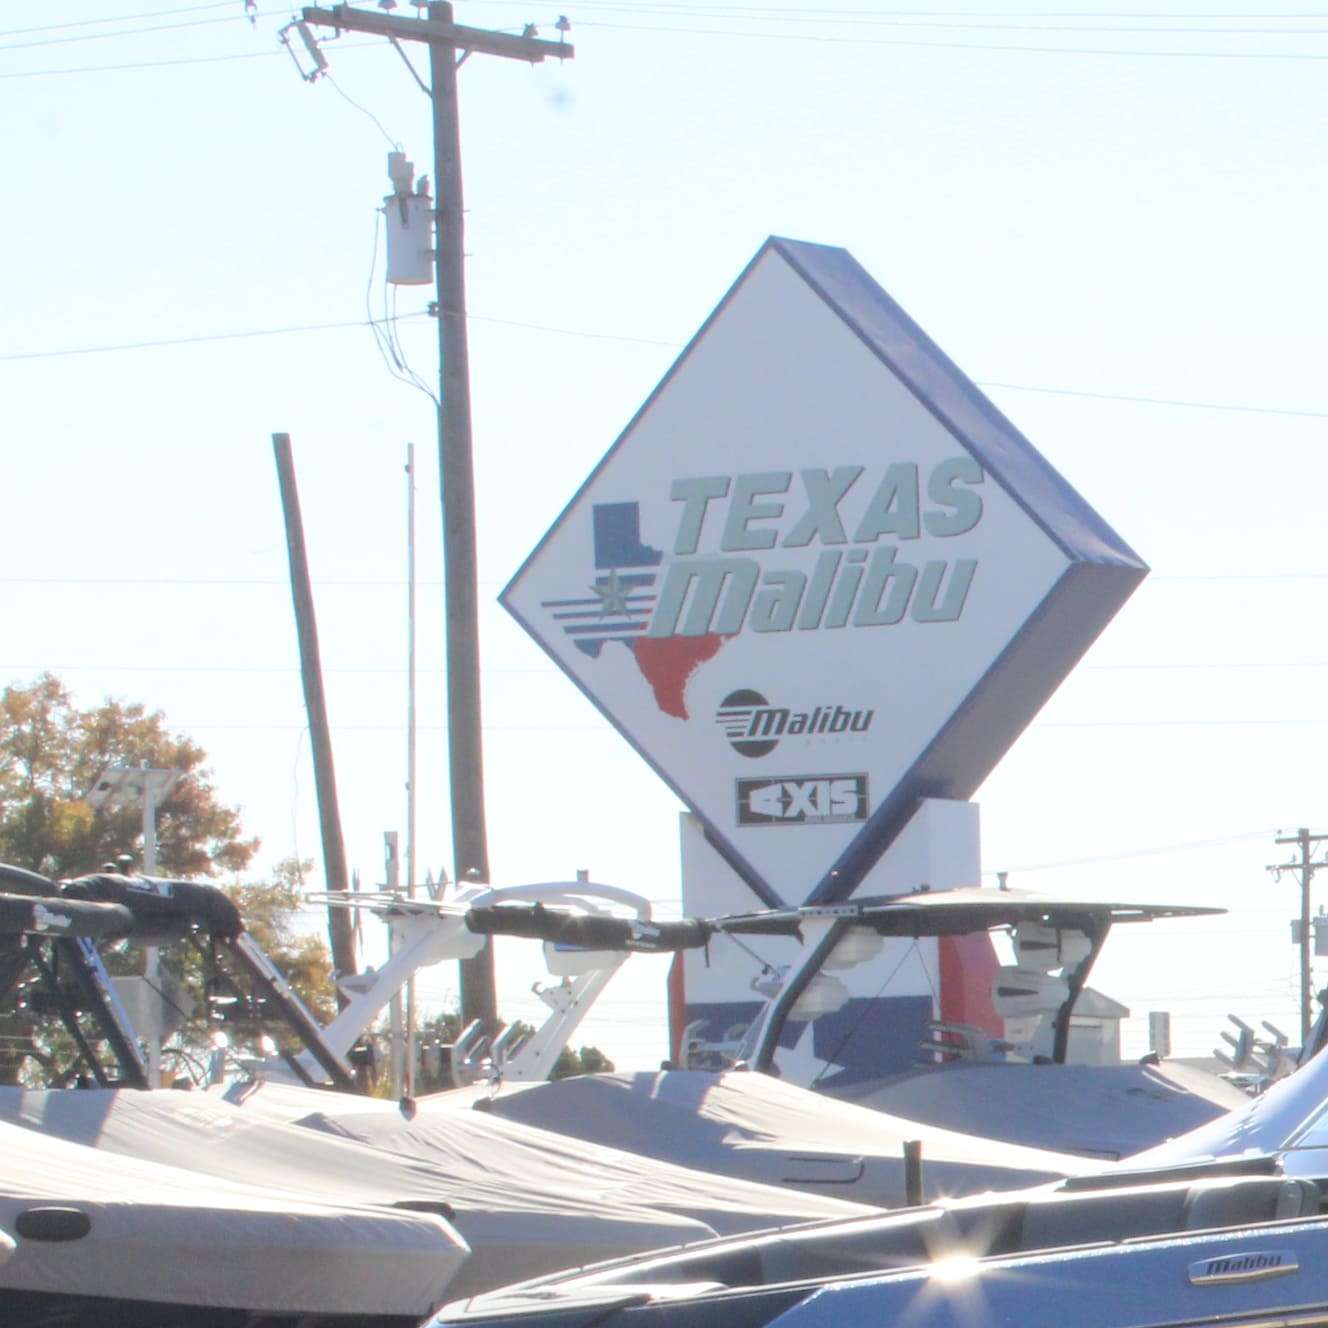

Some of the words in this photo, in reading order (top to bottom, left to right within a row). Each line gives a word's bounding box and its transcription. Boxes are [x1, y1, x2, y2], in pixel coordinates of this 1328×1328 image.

[670, 456, 985, 556] TEXAS
[646, 546, 979, 638] Malibu
[748, 705, 875, 737] Malibu
[750, 779, 858, 818] AXIS
[1206, 1255, 1282, 1275] Malibu
